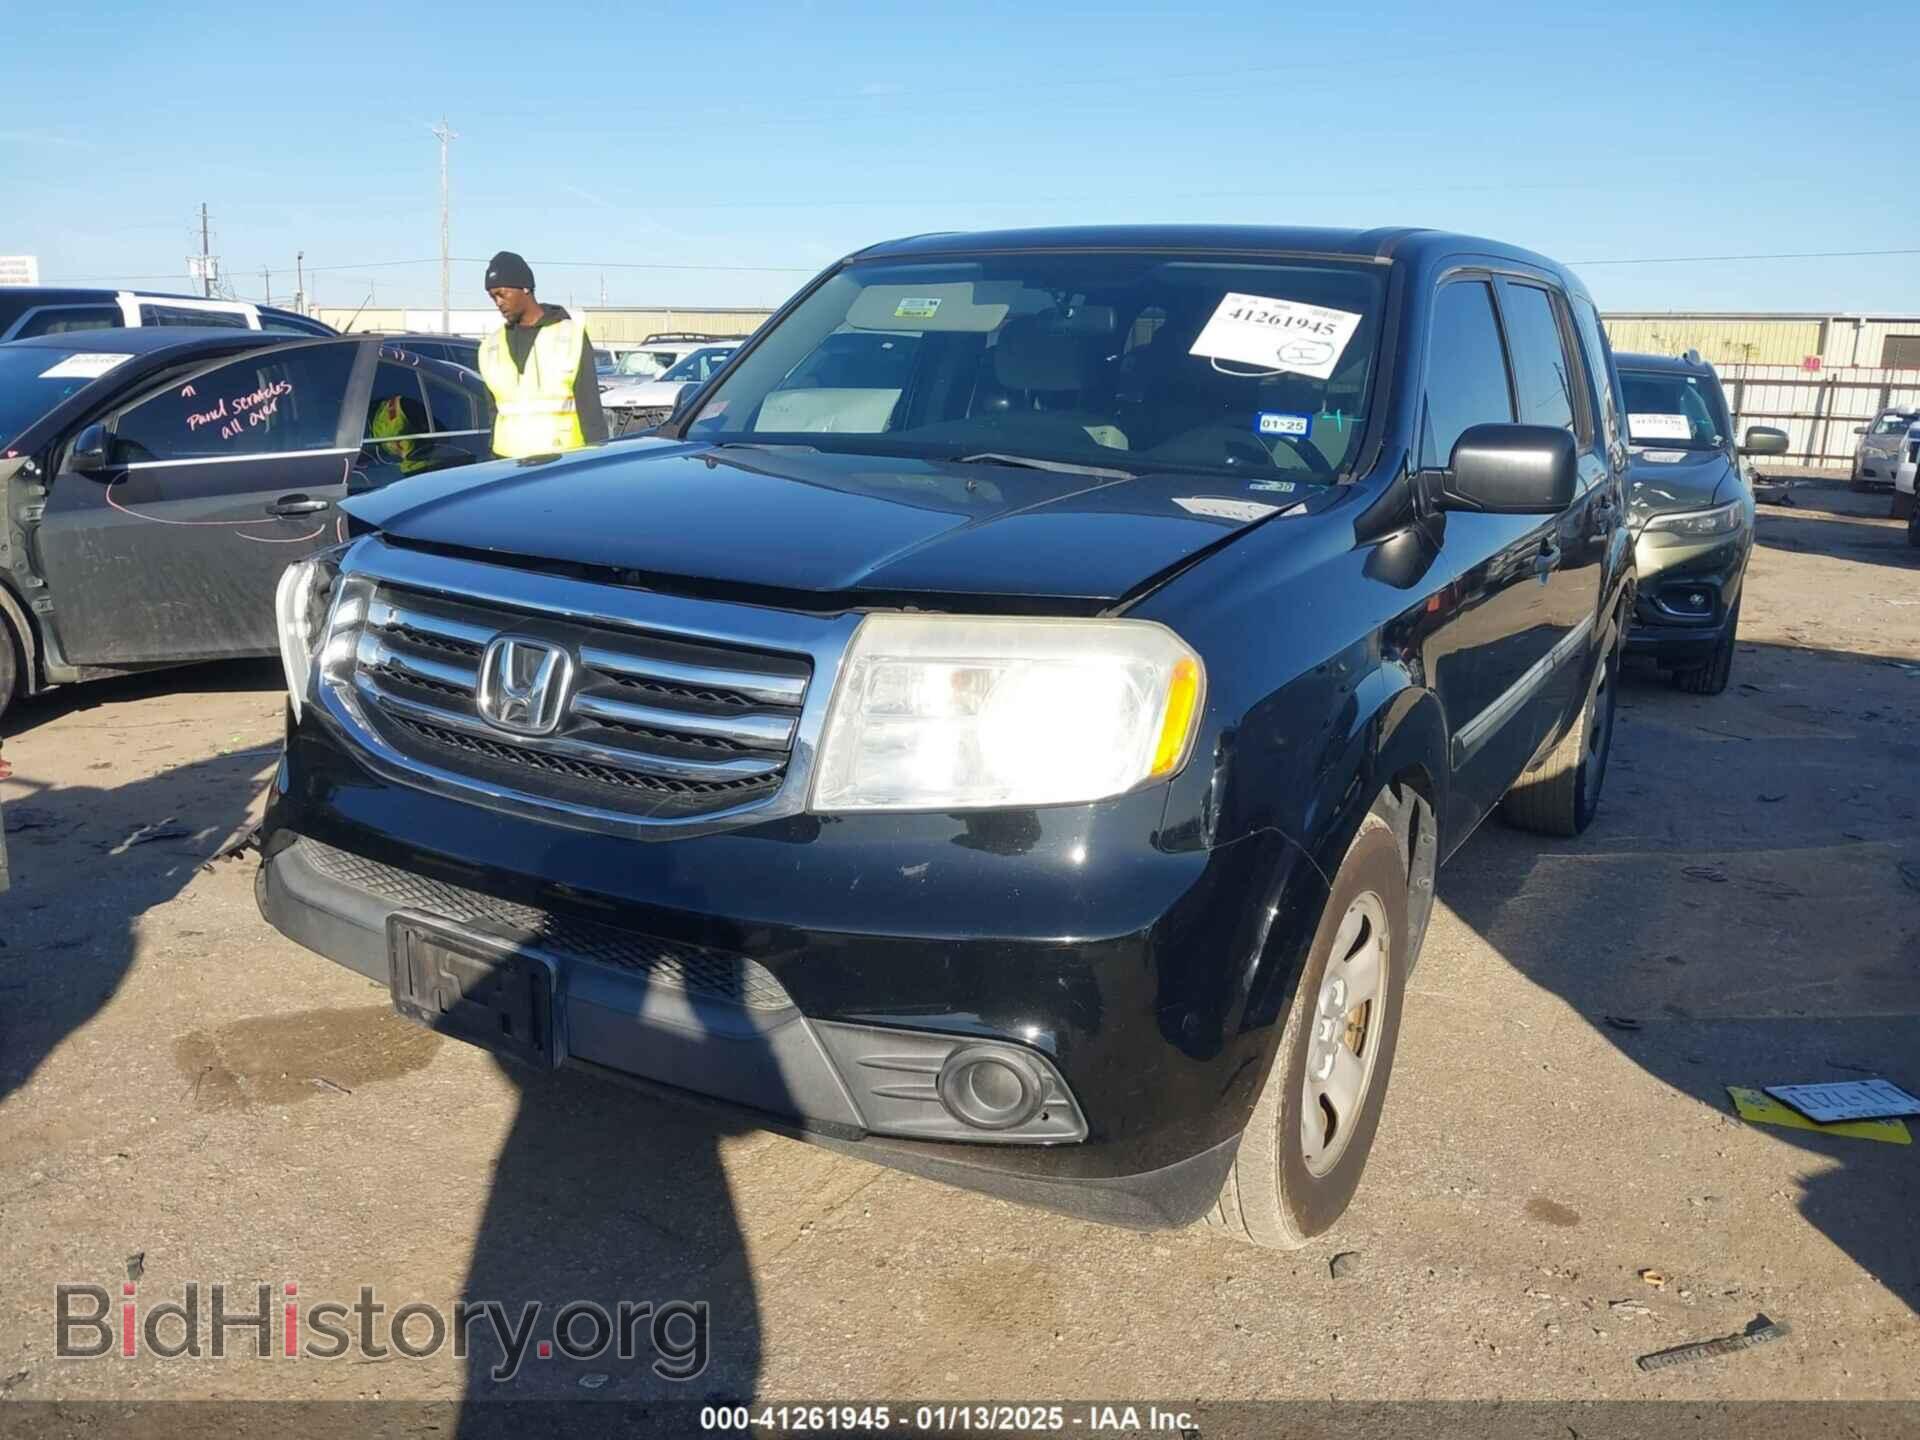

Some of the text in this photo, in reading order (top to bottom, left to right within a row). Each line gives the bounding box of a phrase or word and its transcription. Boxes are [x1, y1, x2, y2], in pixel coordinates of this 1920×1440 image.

[1228, 307, 1337, 336] 41261945
[221, 397, 279, 440] all over
[1261, 418, 1304, 432] 01-25
